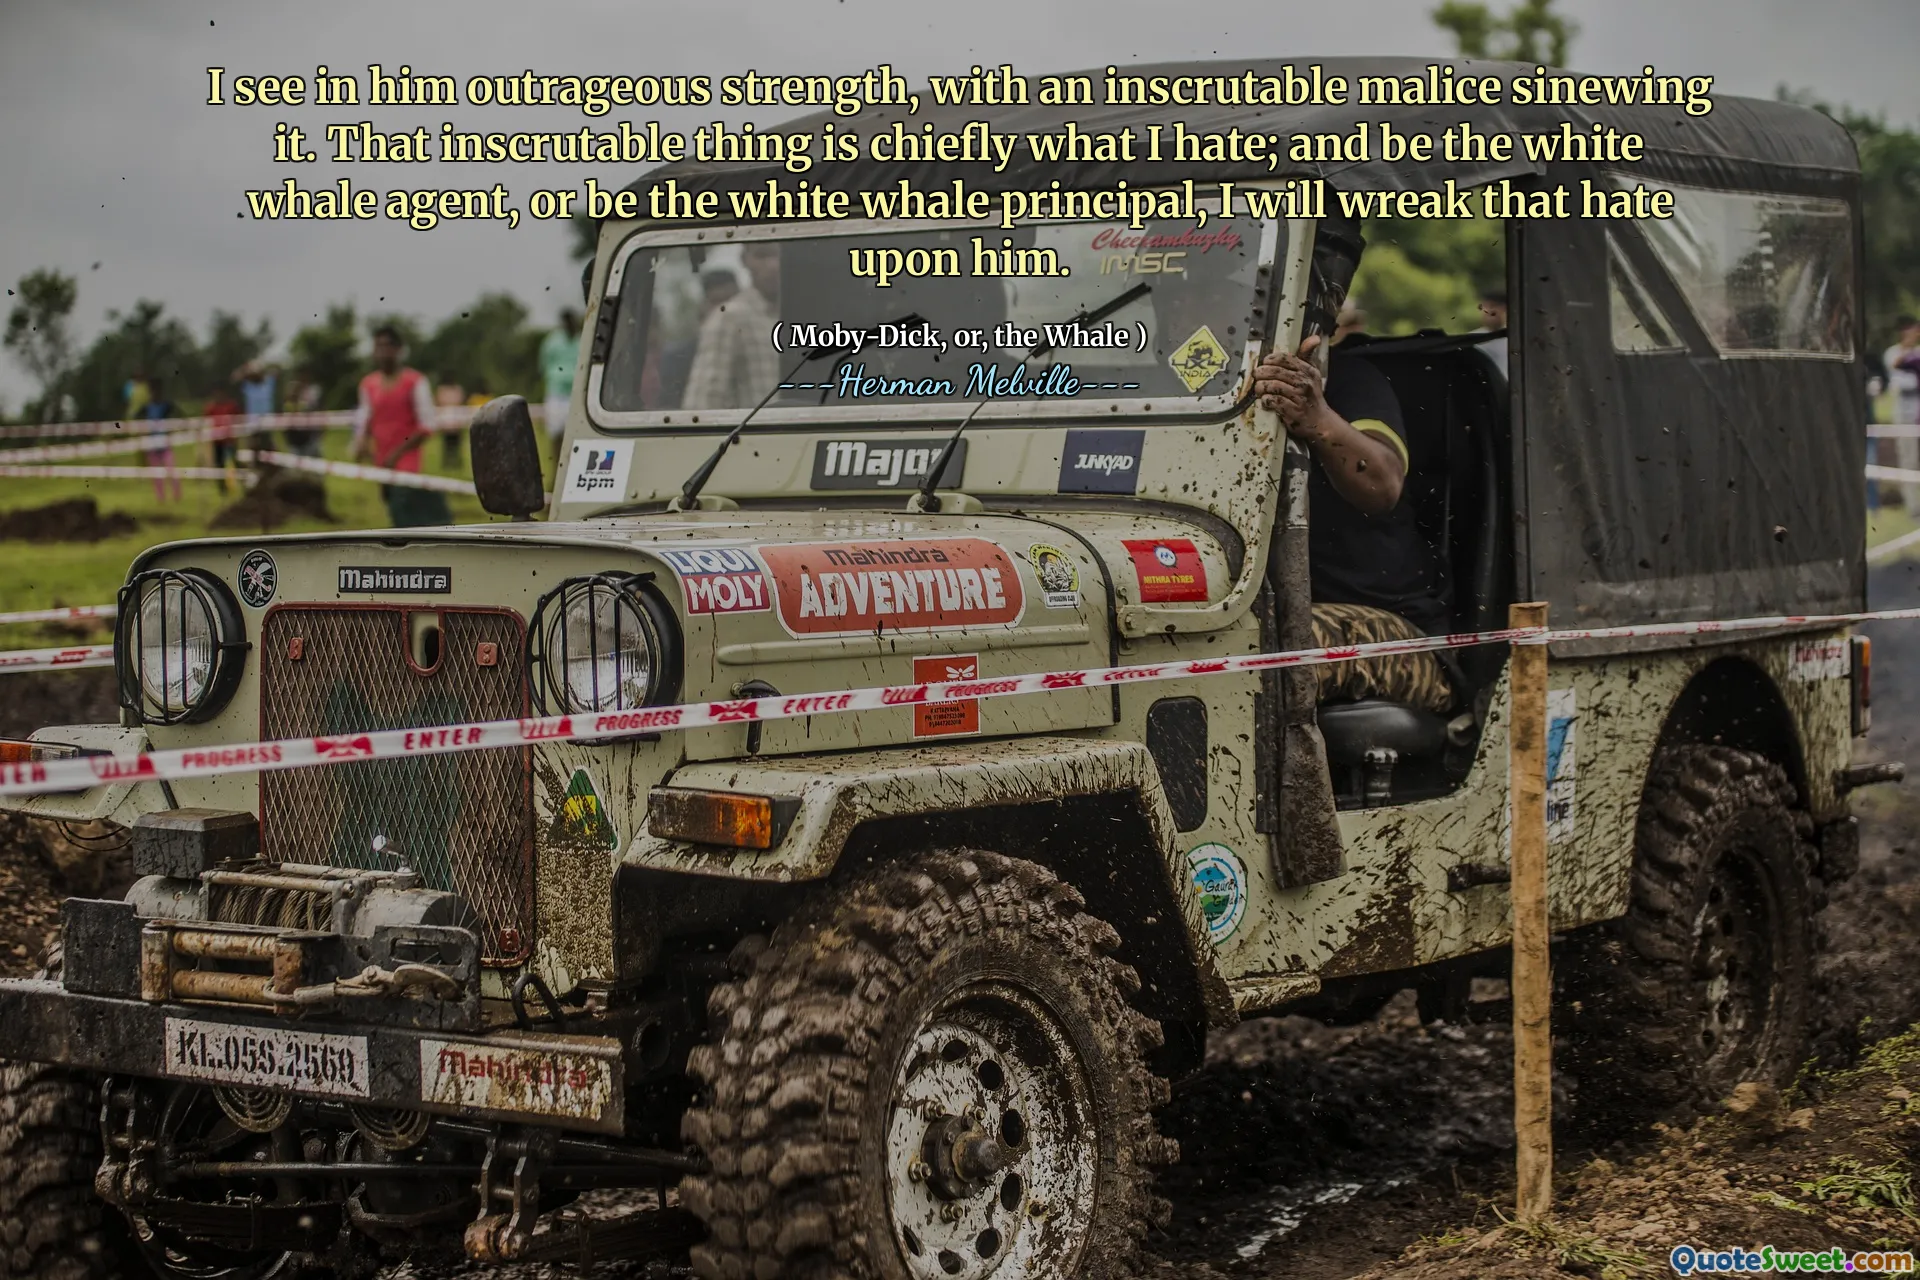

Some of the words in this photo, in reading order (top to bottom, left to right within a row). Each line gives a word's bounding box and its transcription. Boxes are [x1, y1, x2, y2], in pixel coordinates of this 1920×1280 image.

[1180, 369, 1211, 378] INDIA
[1074, 453, 1135, 476] JUNKYAD
[576, 474, 615, 492] bpm
[664, 549, 759, 574] LIQUI
[339, 569, 448, 589] Mahindra
[689, 573, 764, 611] MOLY
[799, 567, 1007, 618] ADVENTURE
[182, 746, 282, 769] PROGRESS
[403, 727, 483, 750] ENTER
[595, 709, 684, 732] PROGRESS
[782, 694, 852, 714] ENTER
[438, 1049, 588, 1089] Mahindra
